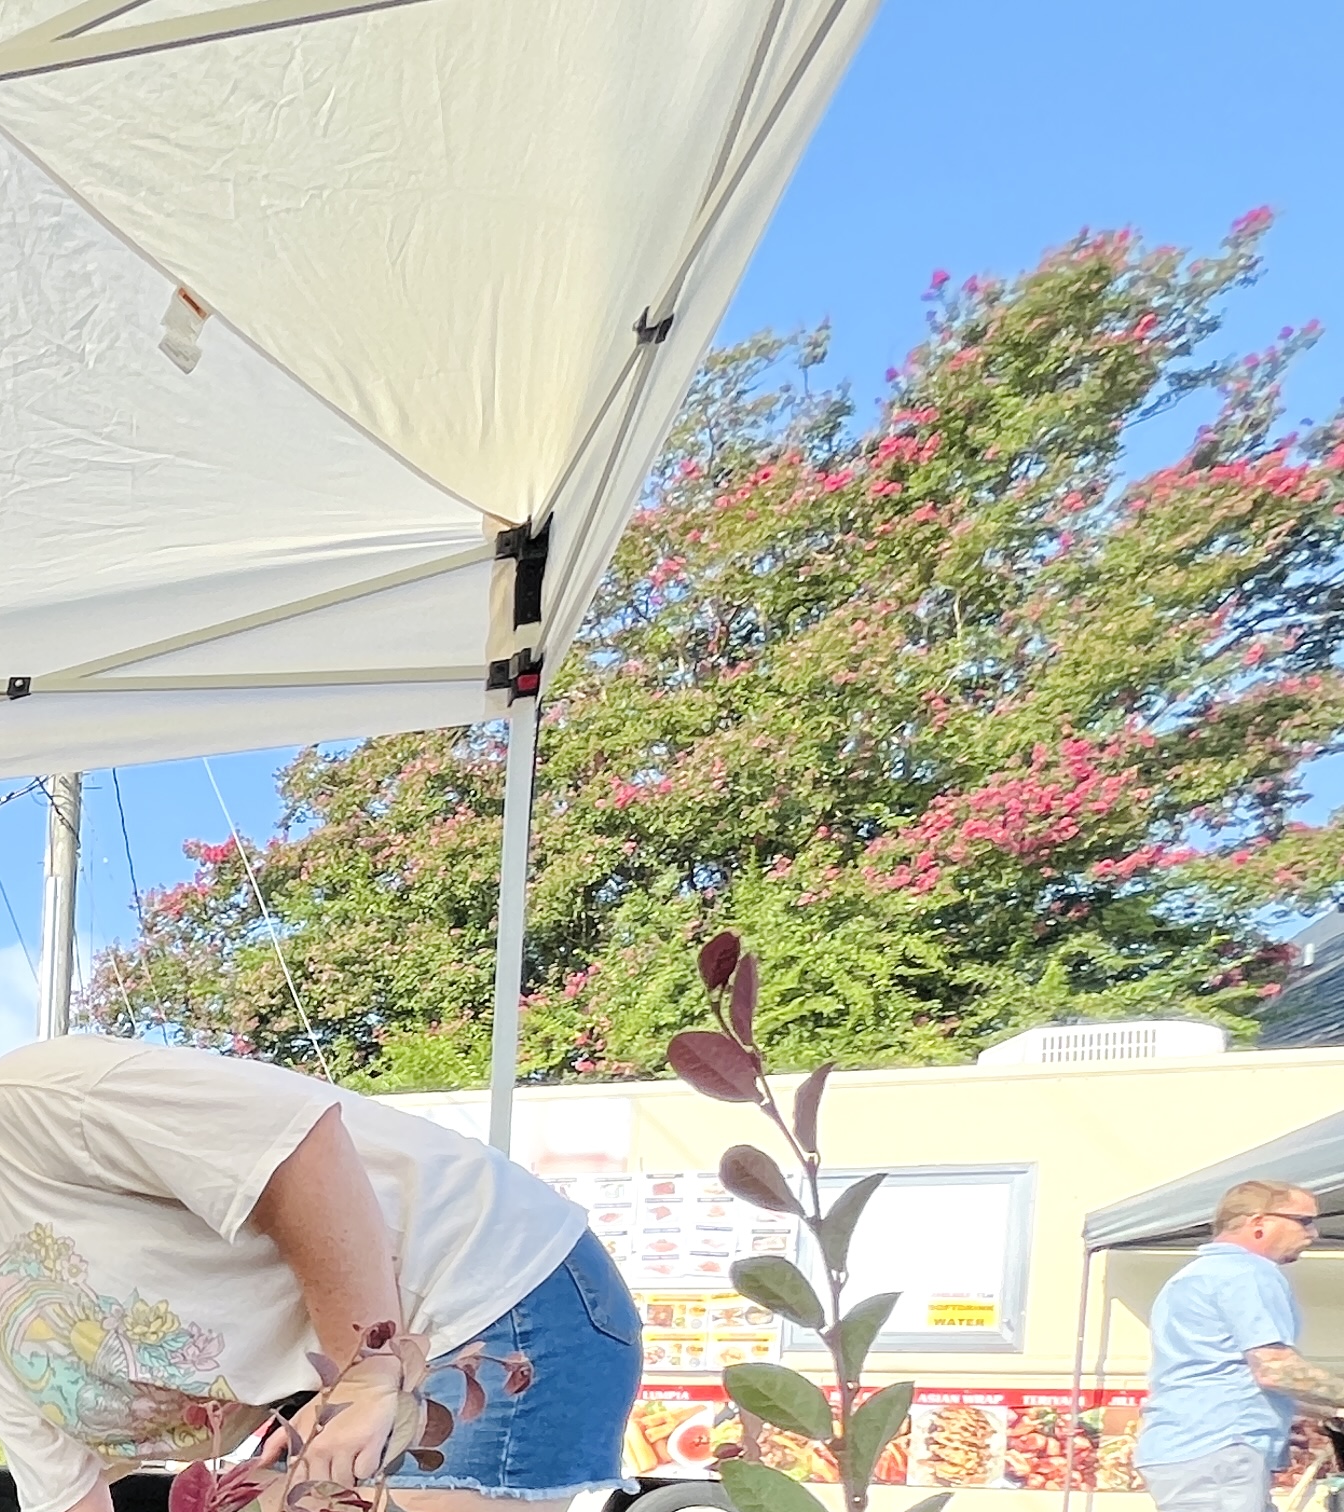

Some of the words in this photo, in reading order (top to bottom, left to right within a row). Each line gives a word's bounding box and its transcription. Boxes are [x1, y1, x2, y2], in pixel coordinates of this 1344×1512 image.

[934, 1318, 984, 1326] WATER
[642, 1390, 689, 1400] LUMPIA
[917, 1393, 961, 1404] ASIAN
